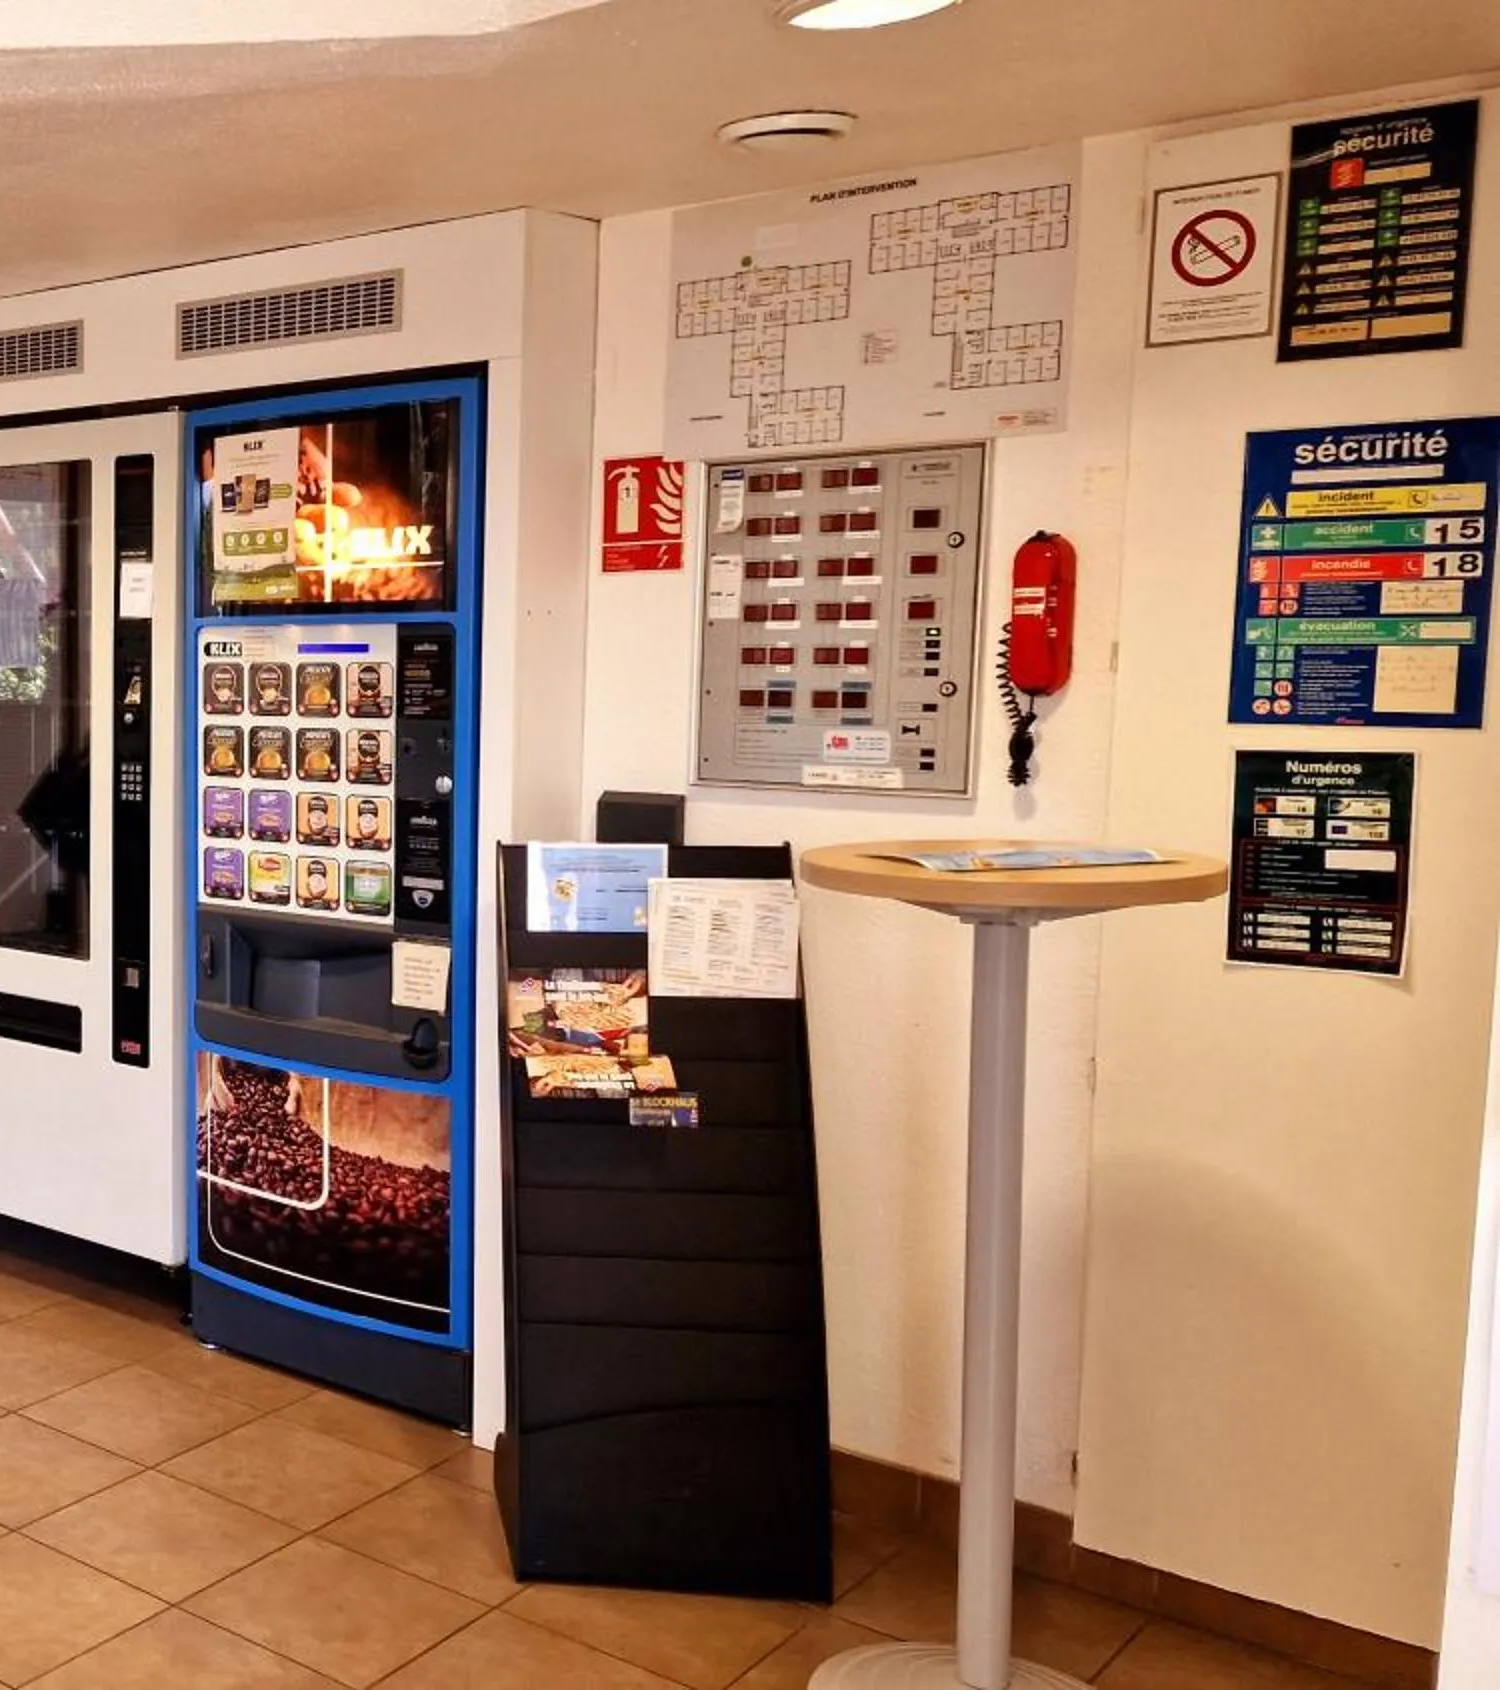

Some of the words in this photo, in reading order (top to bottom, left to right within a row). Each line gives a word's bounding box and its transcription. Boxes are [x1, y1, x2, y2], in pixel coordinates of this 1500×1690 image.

[1293, 429, 1449, 465] sécurité
[1318, 490, 1375, 503] incident
[1314, 524, 1373, 536] accident
[1434, 519, 1481, 544] 15
[1311, 558, 1371, 571] incendie
[1432, 553, 1479, 577] 18
[1299, 619, 1377, 632] évacuation
[210, 641, 241, 656] KLIX
[1285, 760, 1362, 776] Numéros
[1291, 775, 1355, 788] d'urgence
